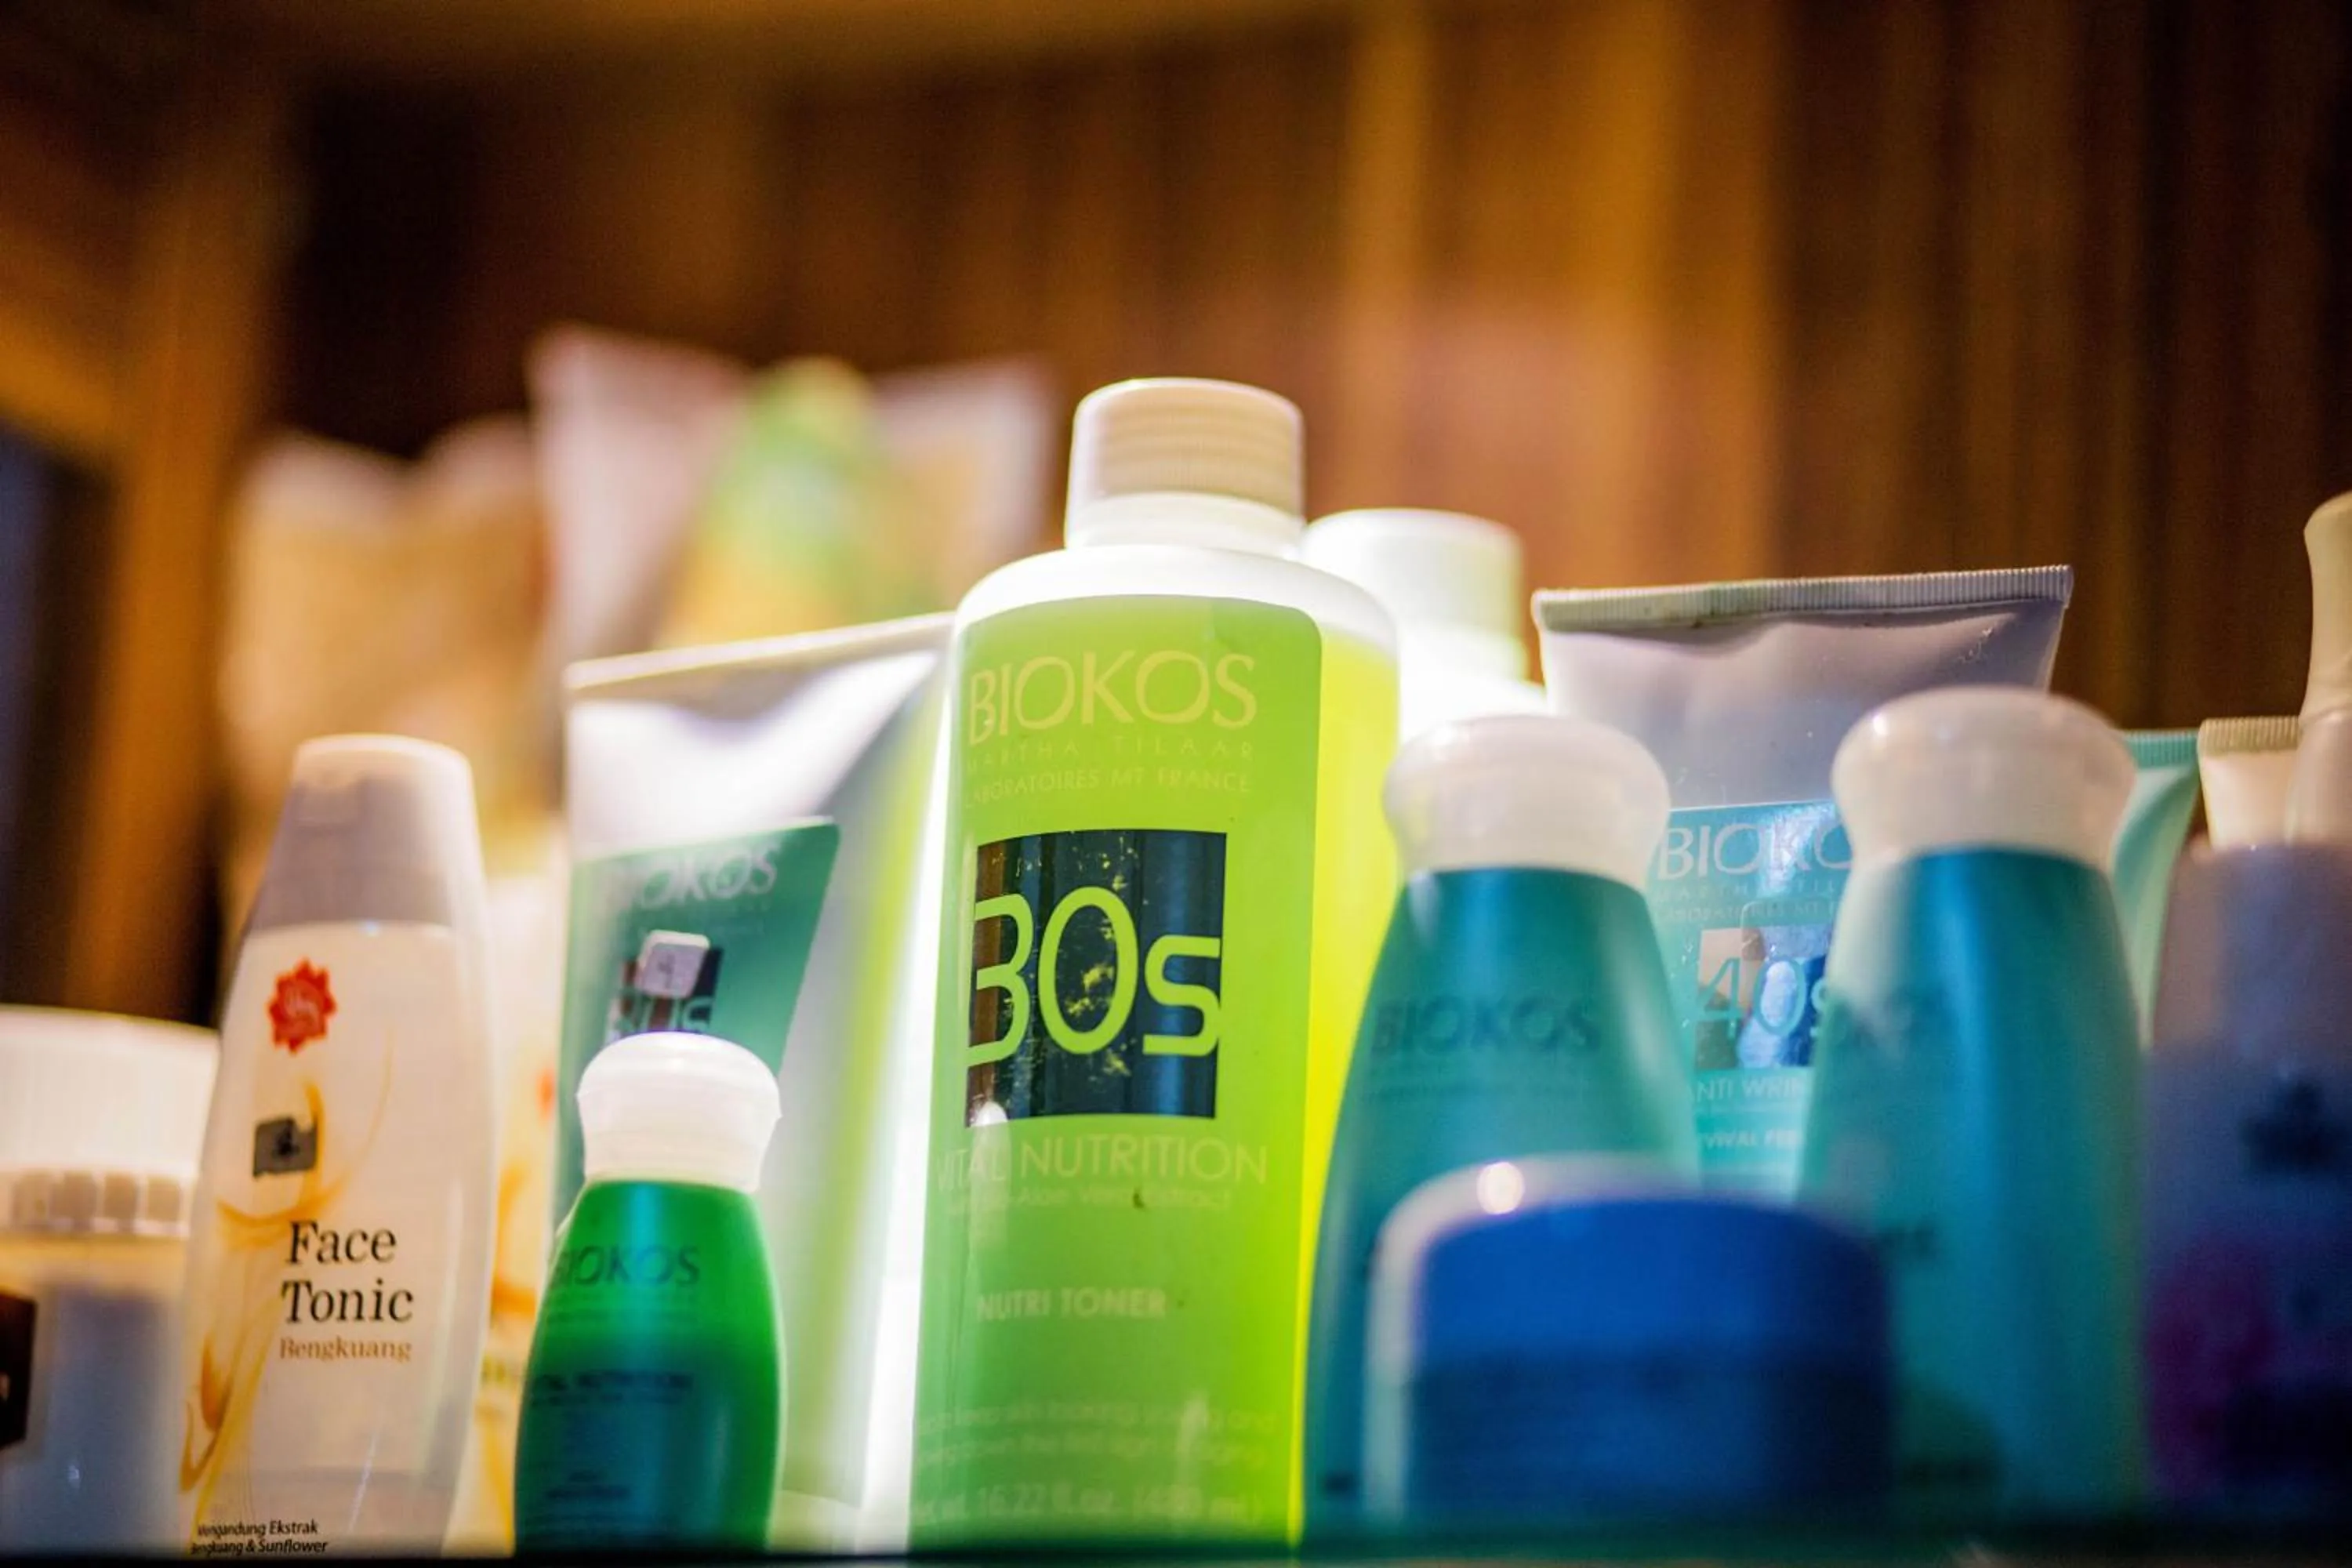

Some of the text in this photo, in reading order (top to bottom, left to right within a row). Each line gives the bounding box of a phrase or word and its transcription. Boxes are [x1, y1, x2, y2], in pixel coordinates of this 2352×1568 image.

[969, 650, 1258, 746] BIOKOS
[1112, 735, 1254, 761] TILAAR
[1111, 766, 1145, 790] MT
[1157, 765, 1254, 794] FRANCE
[1657, 822, 1853, 880] BIOKO
[967, 886, 1221, 1067] 30s
[1687, 1078, 1732, 1102] NTI
[1021, 1133, 1268, 1185] NUTRITION
[285, 1220, 397, 1265] Face
[281, 1276, 413, 1323] Tonic
[975, 1286, 1167, 1323] NUTRI TONER
[279, 1334, 412, 1363] Bengkuang
[245, 1539, 256, 1554] &
[258, 1537, 328, 1555] Sunflower
[270, 1519, 319, 1536] Ekstrak
